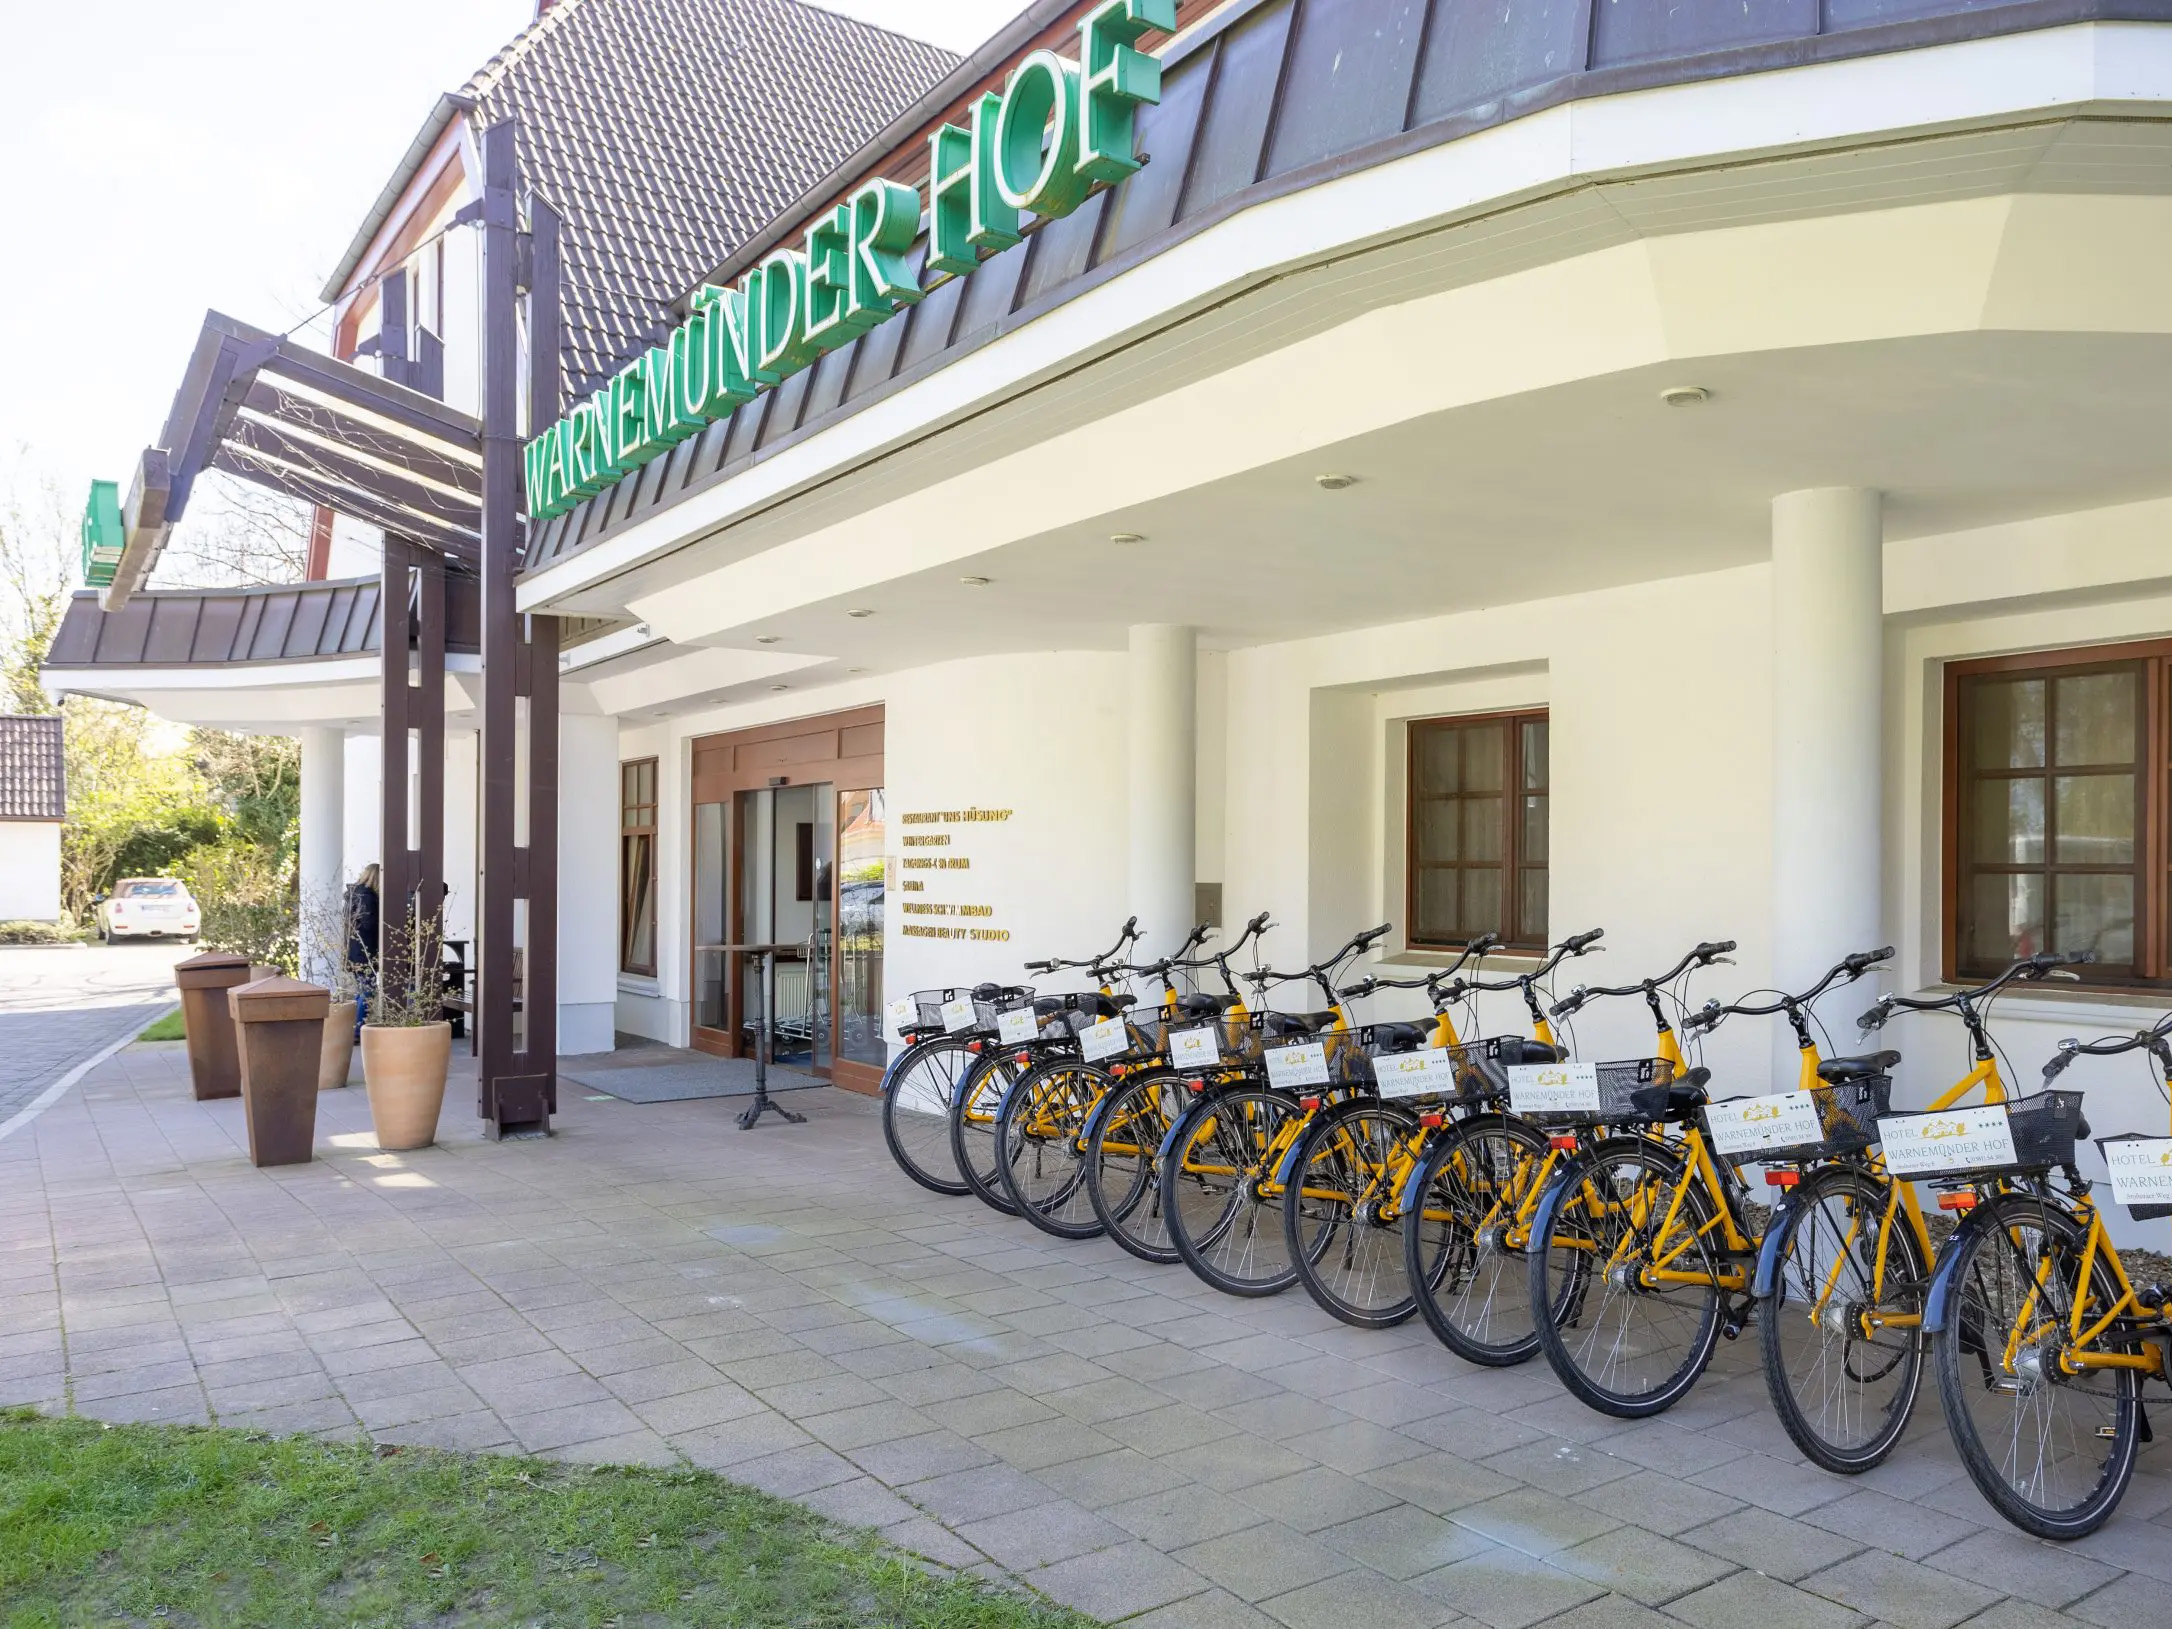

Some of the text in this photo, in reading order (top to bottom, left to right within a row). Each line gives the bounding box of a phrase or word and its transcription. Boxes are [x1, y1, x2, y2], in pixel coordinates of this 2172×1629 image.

[524, 0, 1177, 520] WARNEMÜNDER HOF
[969, 929, 1010, 941] STUDIO
[1710, 1112, 1738, 1124] HOTEL
[1795, 1119, 1816, 1130] HOF
[1883, 1128, 1919, 1141] HOTEL
[1888, 1138, 2010, 1160] WARNEMÜNDER HOF
[2111, 1154, 2156, 1166] HOTEL
